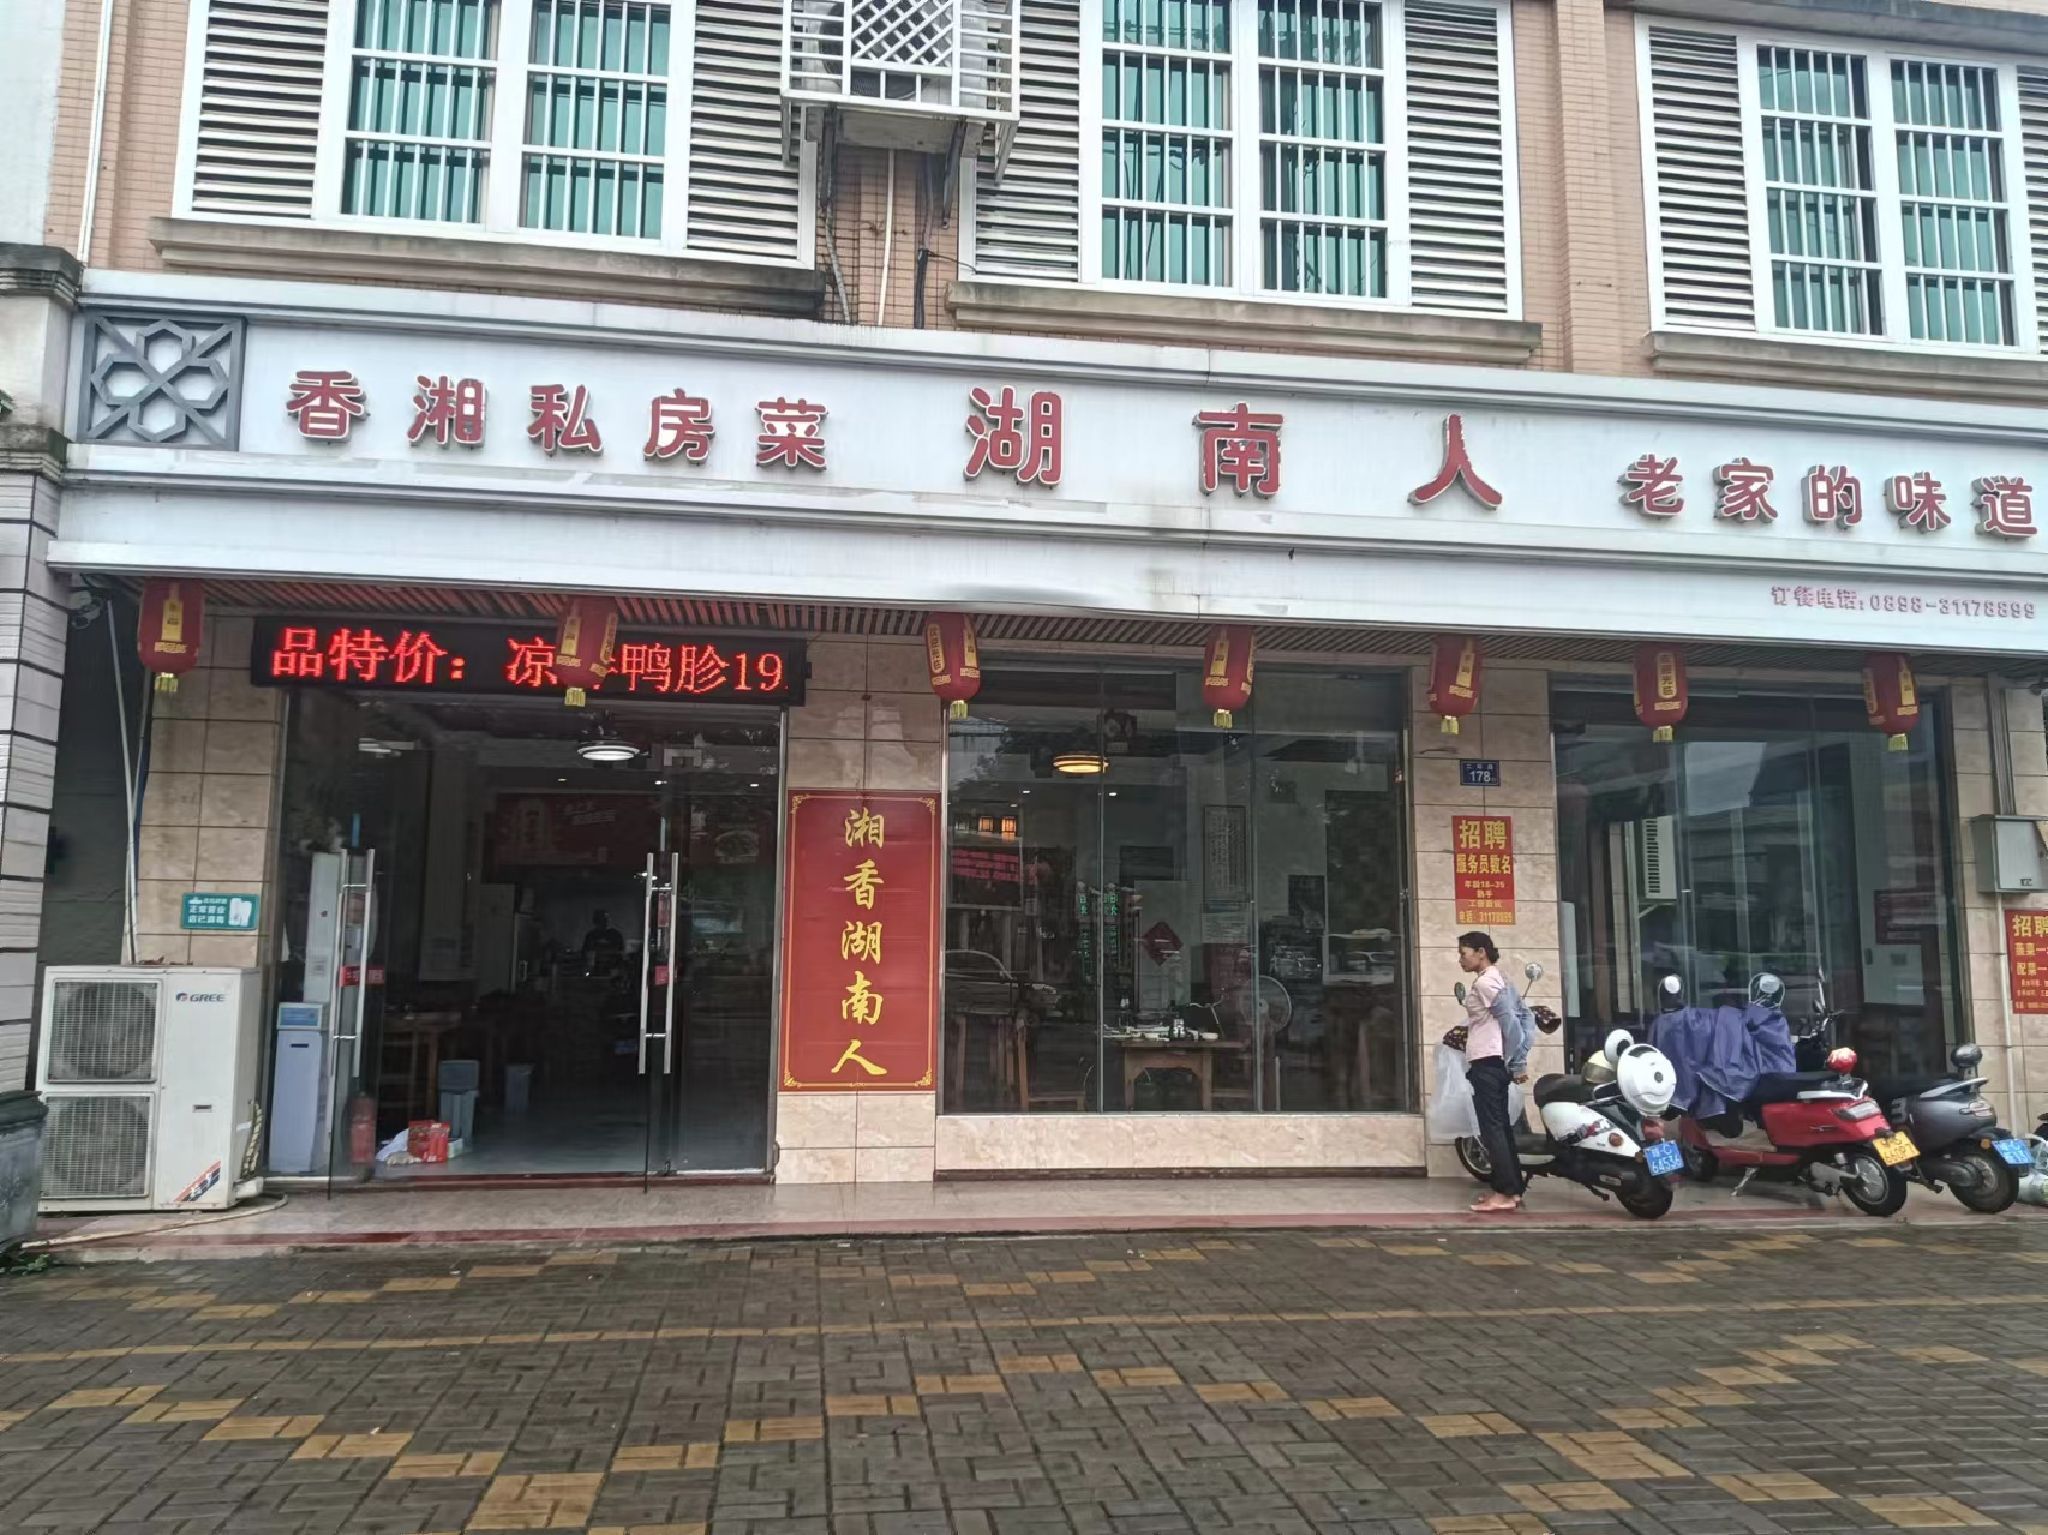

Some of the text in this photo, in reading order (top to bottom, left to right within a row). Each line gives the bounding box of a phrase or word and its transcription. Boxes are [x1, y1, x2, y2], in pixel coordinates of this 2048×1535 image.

[286, 369, 2038, 539] 香湘私房菜 湖南人 老家的味道
[1459, 819, 1507, 850] 招聘
[1456, 854, 1511, 875] 服务员数名
[831, 807, 888, 1076] 湘香湖南人
[189, 993, 226, 1002] GREE
